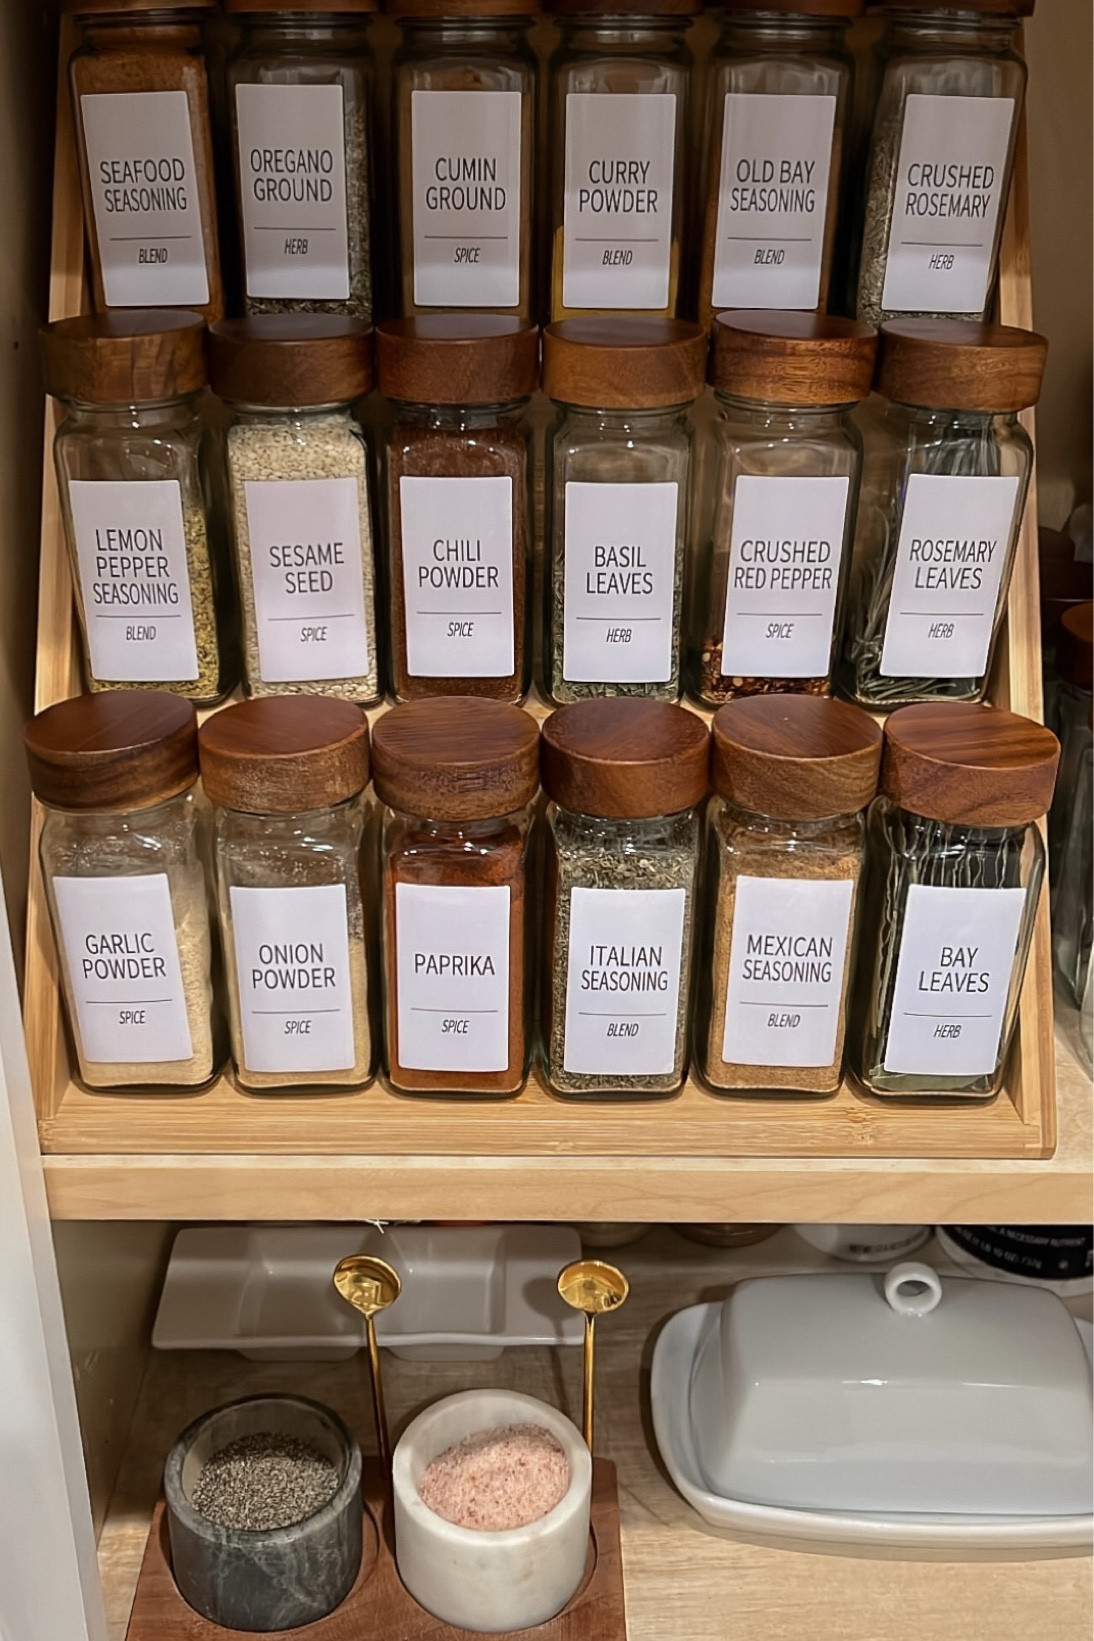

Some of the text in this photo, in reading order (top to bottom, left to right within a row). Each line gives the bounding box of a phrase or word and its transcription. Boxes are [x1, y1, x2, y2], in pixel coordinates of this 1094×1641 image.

[100, 159, 184, 184] SEAFOOD
[251, 149, 332, 173] OREGANO
[435, 158, 496, 181] CUMIN
[737, 159, 815, 184] OLD BAY
[589, 160, 650, 184] CURRY
[908, 164, 994, 189] CRUSHED
[105, 187, 186, 212] SEASONING
[254, 178, 332, 201] GROUND
[426, 186, 505, 210] GROUND
[730, 187, 815, 212] SEASONING
[580, 189, 657, 213] POWDER
[906, 193, 990, 218] ROSEMARY
[139, 248, 168, 263] BLEND
[285, 239, 308, 254] HERB
[454, 247, 480, 263] SPICE
[754, 249, 784, 264] BLEND
[602, 250, 632, 265] BLEND
[929, 254, 954, 269] HERB
[96, 529, 162, 551] LEMON
[433, 540, 480, 561] CHILI
[910, 539, 997, 562] ROSEMARY
[270, 543, 344, 567] SESAME
[595, 546, 646, 567] BASIL
[741, 540, 830, 563] CRUSHED
[96, 556, 169, 577] PEPPER
[419, 566, 498, 588] POWDER
[286, 571, 332, 593] SEED
[587, 572, 652, 594] LEAVES
[734, 567, 832, 589] RED PEPPER
[915, 567, 982, 589] LEAVES
[93, 583, 178, 604] SEASONING
[126, 626, 156, 640] BLEND
[301, 626, 327, 642] SPICE
[447, 622, 474, 636] SPICE
[606, 628, 632, 642] HERB
[766, 623, 794, 638] SPICE
[928, 623, 954, 638] HERB
[86, 933, 154, 954] GARLIC
[259, 944, 323, 964] ONION
[747, 934, 832, 957] MEXICAN
[415, 954, 495, 976] PAPRIKA
[591, 946, 662, 967] ITALIAN
[941, 947, 978, 967] BAY
[82, 957, 166, 979] POWDER
[252, 968, 335, 989] POWDER
[742, 959, 832, 982] SEASONING
[581, 970, 667, 991] SEASONING
[919, 971, 989, 992] LEAVES
[119, 1010, 145, 1024] SPICE
[284, 1020, 311, 1034] SPICE
[442, 1020, 469, 1033] SPICE
[768, 1014, 800, 1027] BLEND
[607, 1023, 639, 1036] BLEND
[934, 1025, 961, 1038] HERB
